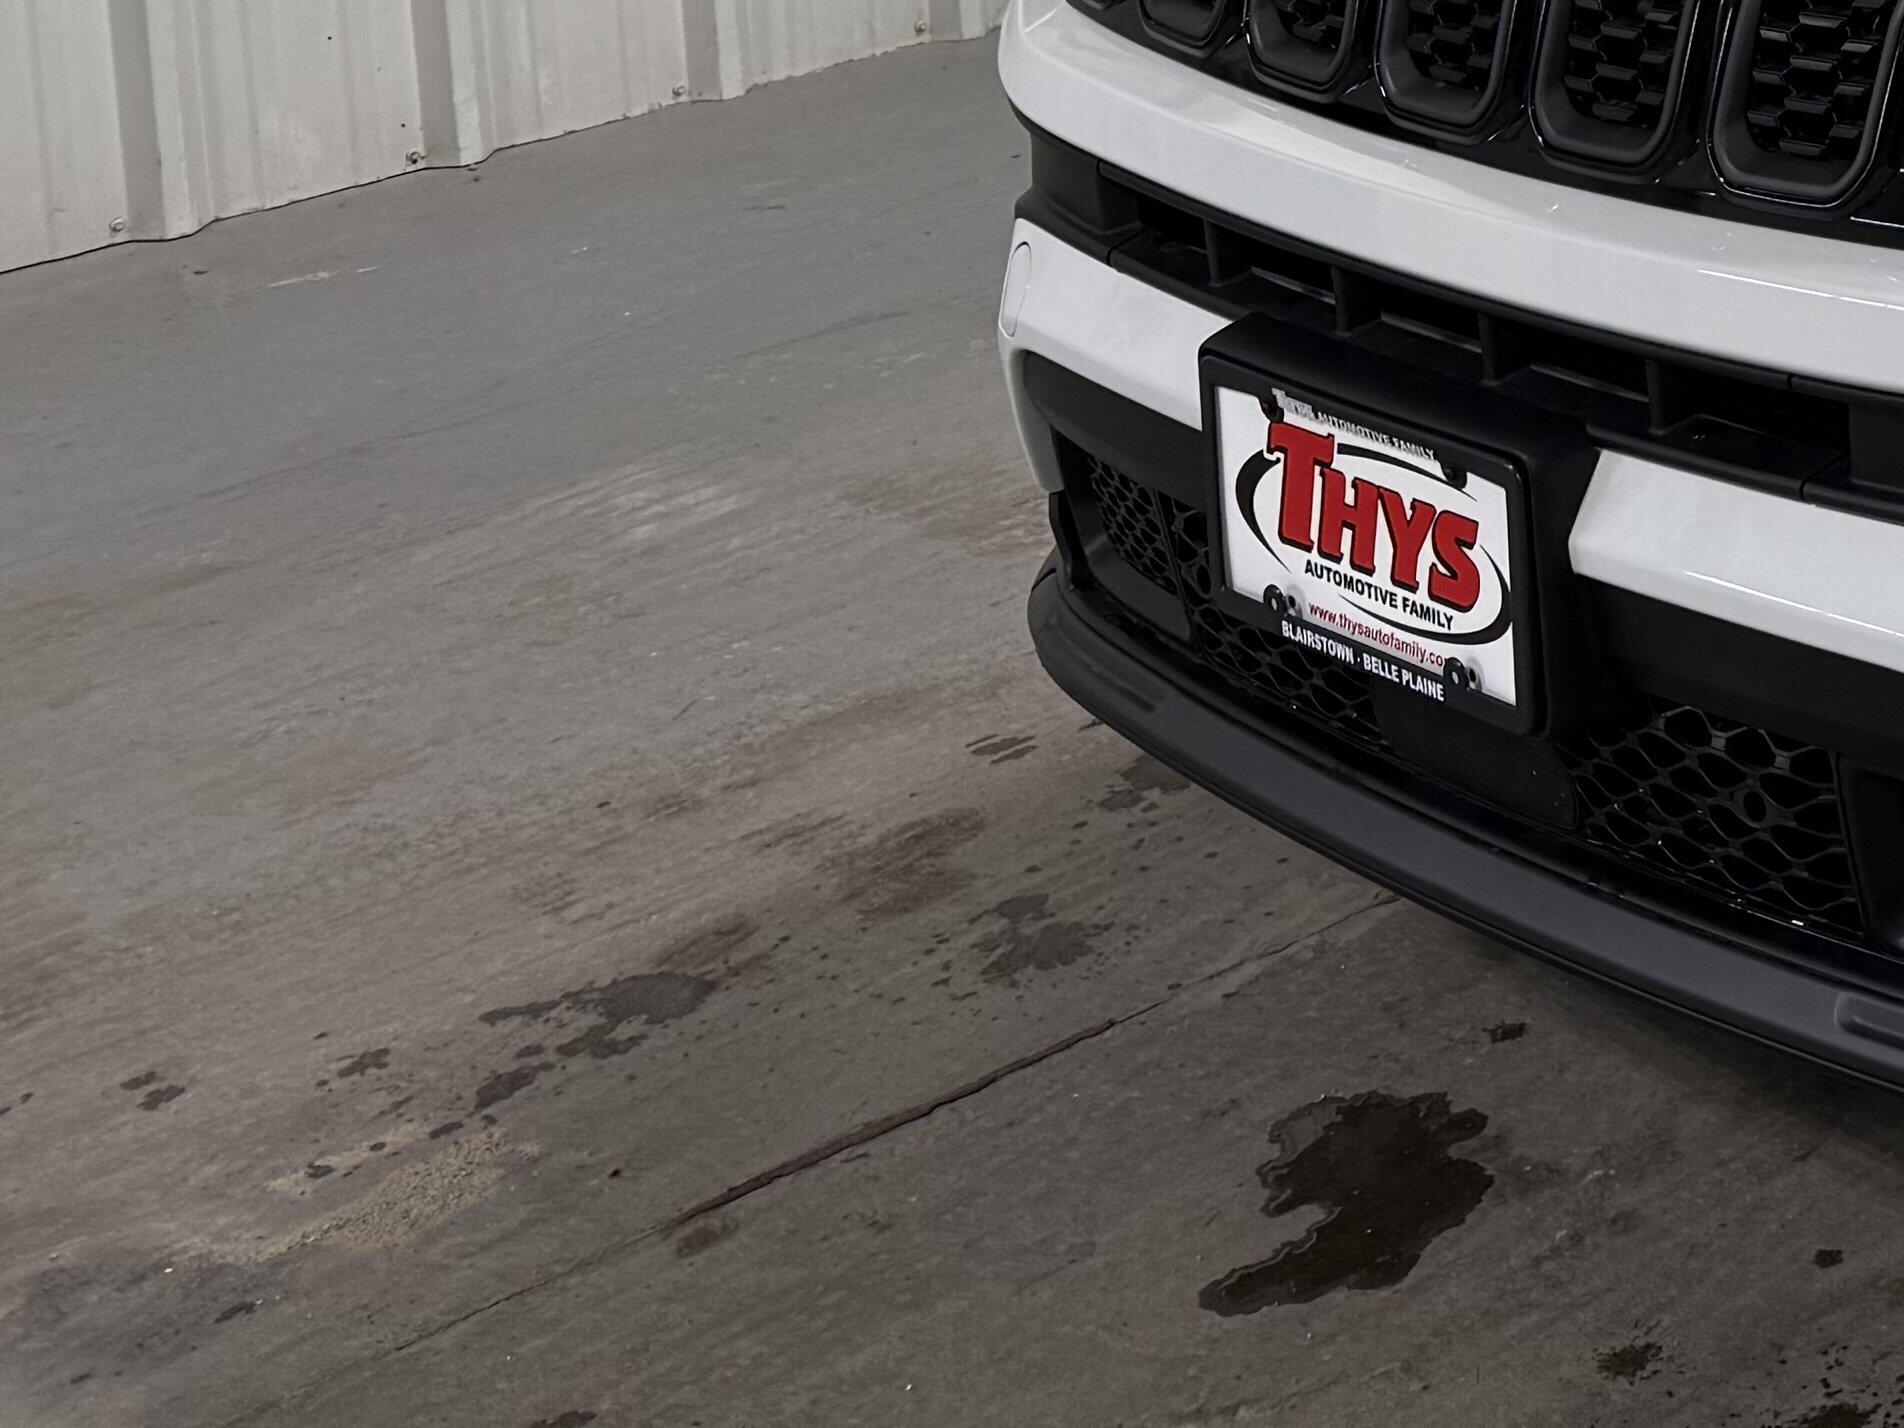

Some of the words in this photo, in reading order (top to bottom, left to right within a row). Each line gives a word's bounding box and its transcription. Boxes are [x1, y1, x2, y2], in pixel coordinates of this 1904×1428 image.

[1266, 420, 1481, 613] THYS
[1304, 558, 1398, 609] AUTOMOTIVE
[1402, 596, 1454, 632] FAMILY
[1281, 619, 1355, 666] BLAIRSTOWN
[1363, 652, 1400, 683] BELLE
[1402, 668, 1445, 703] PLAINE
[1308, 602, 1448, 668] www.thysautofamily.co
